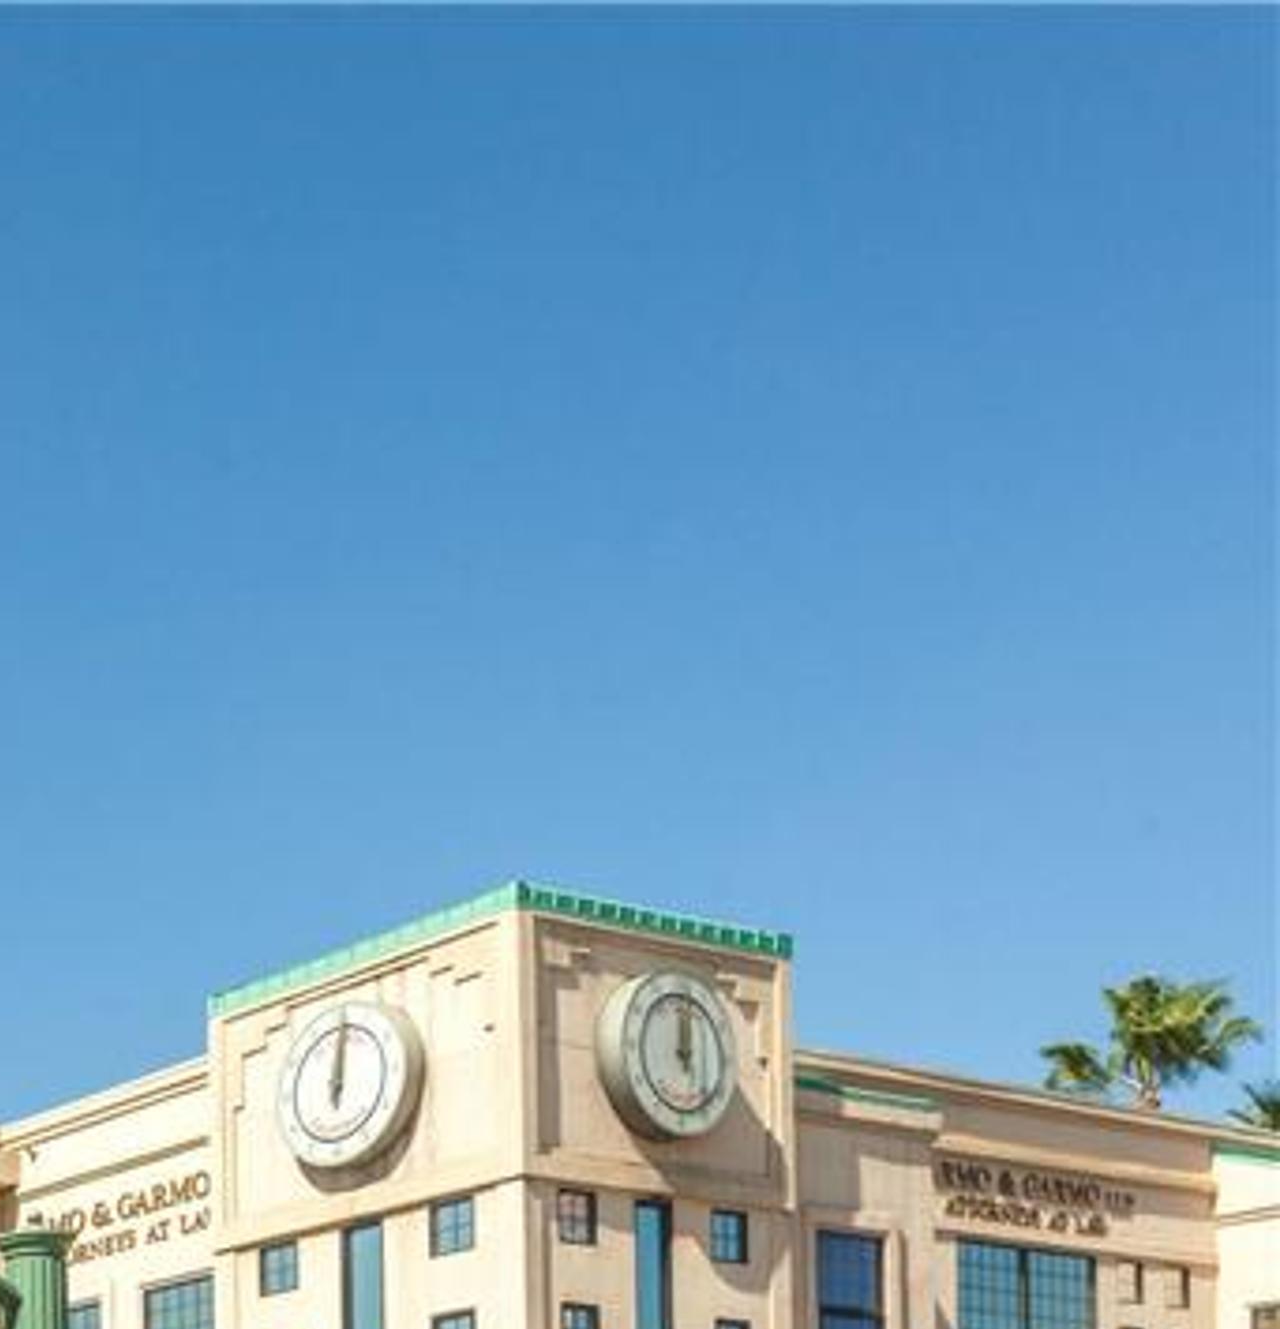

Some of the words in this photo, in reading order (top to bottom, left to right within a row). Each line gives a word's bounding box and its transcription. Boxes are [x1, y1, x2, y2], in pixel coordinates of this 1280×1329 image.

[91, 1202, 115, 1227] &
[116, 1170, 212, 1219] GARMO
[145, 1218, 171, 1246] AT
